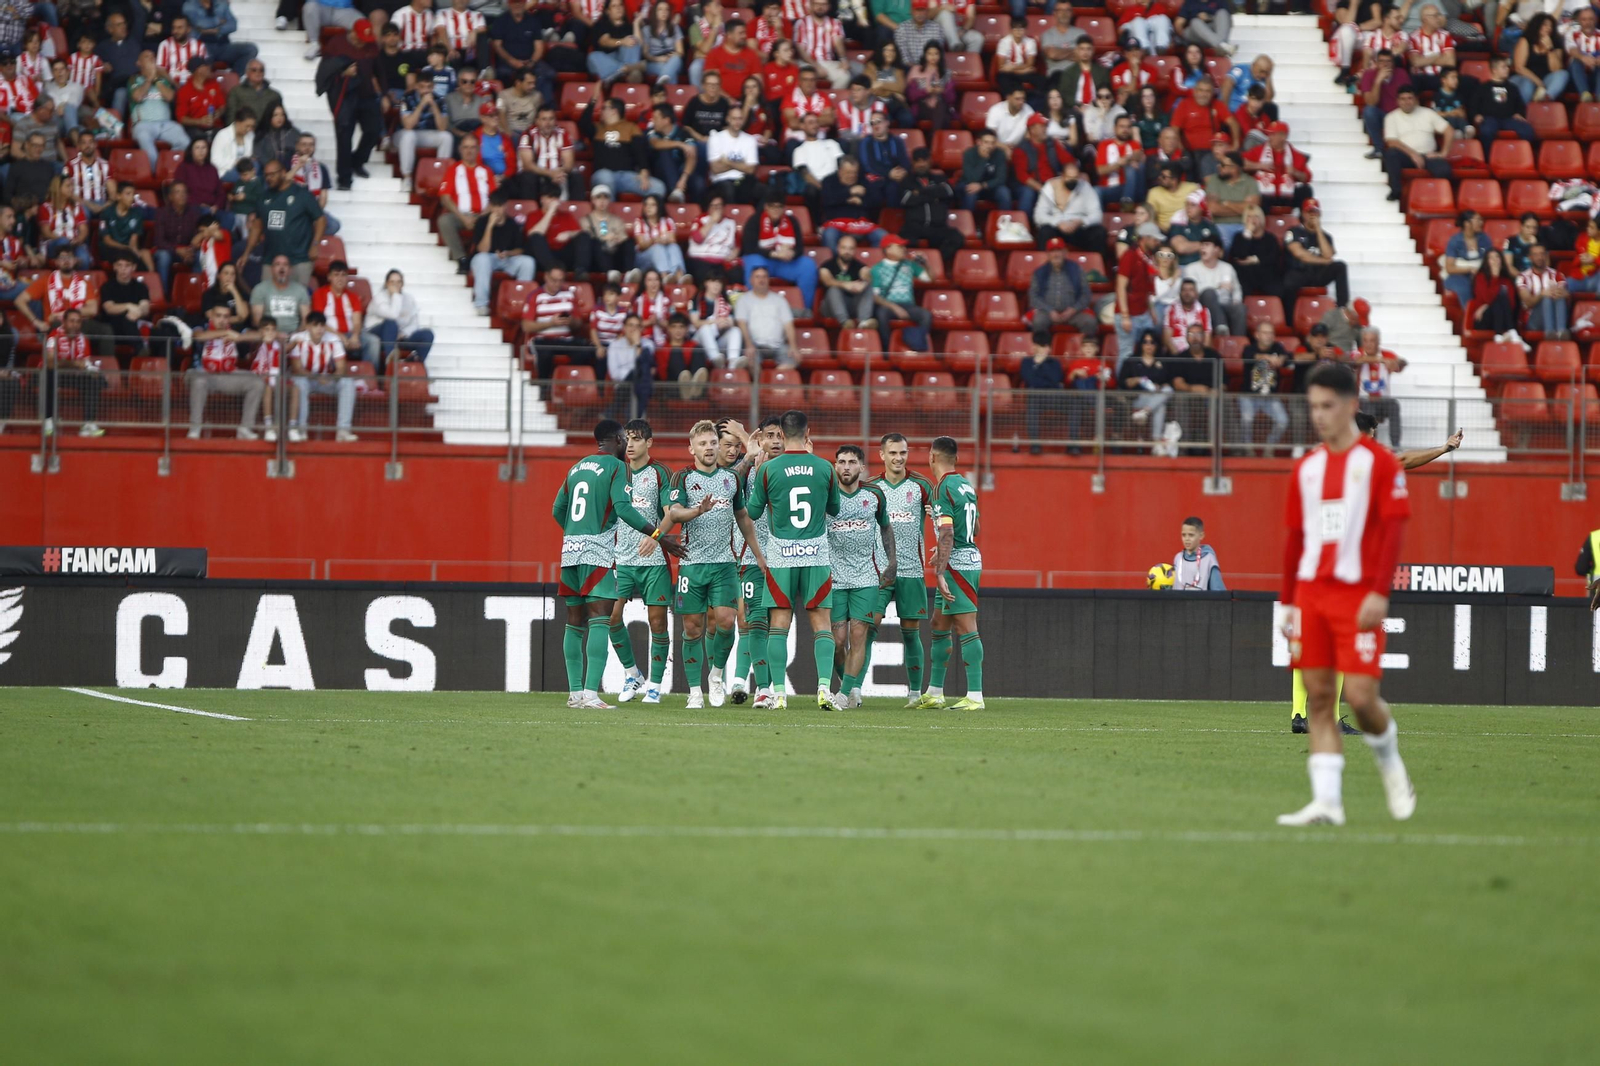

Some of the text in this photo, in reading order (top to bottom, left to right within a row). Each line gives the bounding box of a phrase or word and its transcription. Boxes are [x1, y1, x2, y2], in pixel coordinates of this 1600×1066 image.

[784, 465, 814, 478] INSUA
[571, 481, 589, 522] 6
[789, 486, 812, 529] 5
[42, 547, 156, 573] #FANCAM
[782, 543, 819, 557] wiber
[677, 575, 689, 594] 18
[1393, 565, 1505, 592] #FANCAM
[741, 581, 754, 599] 19
